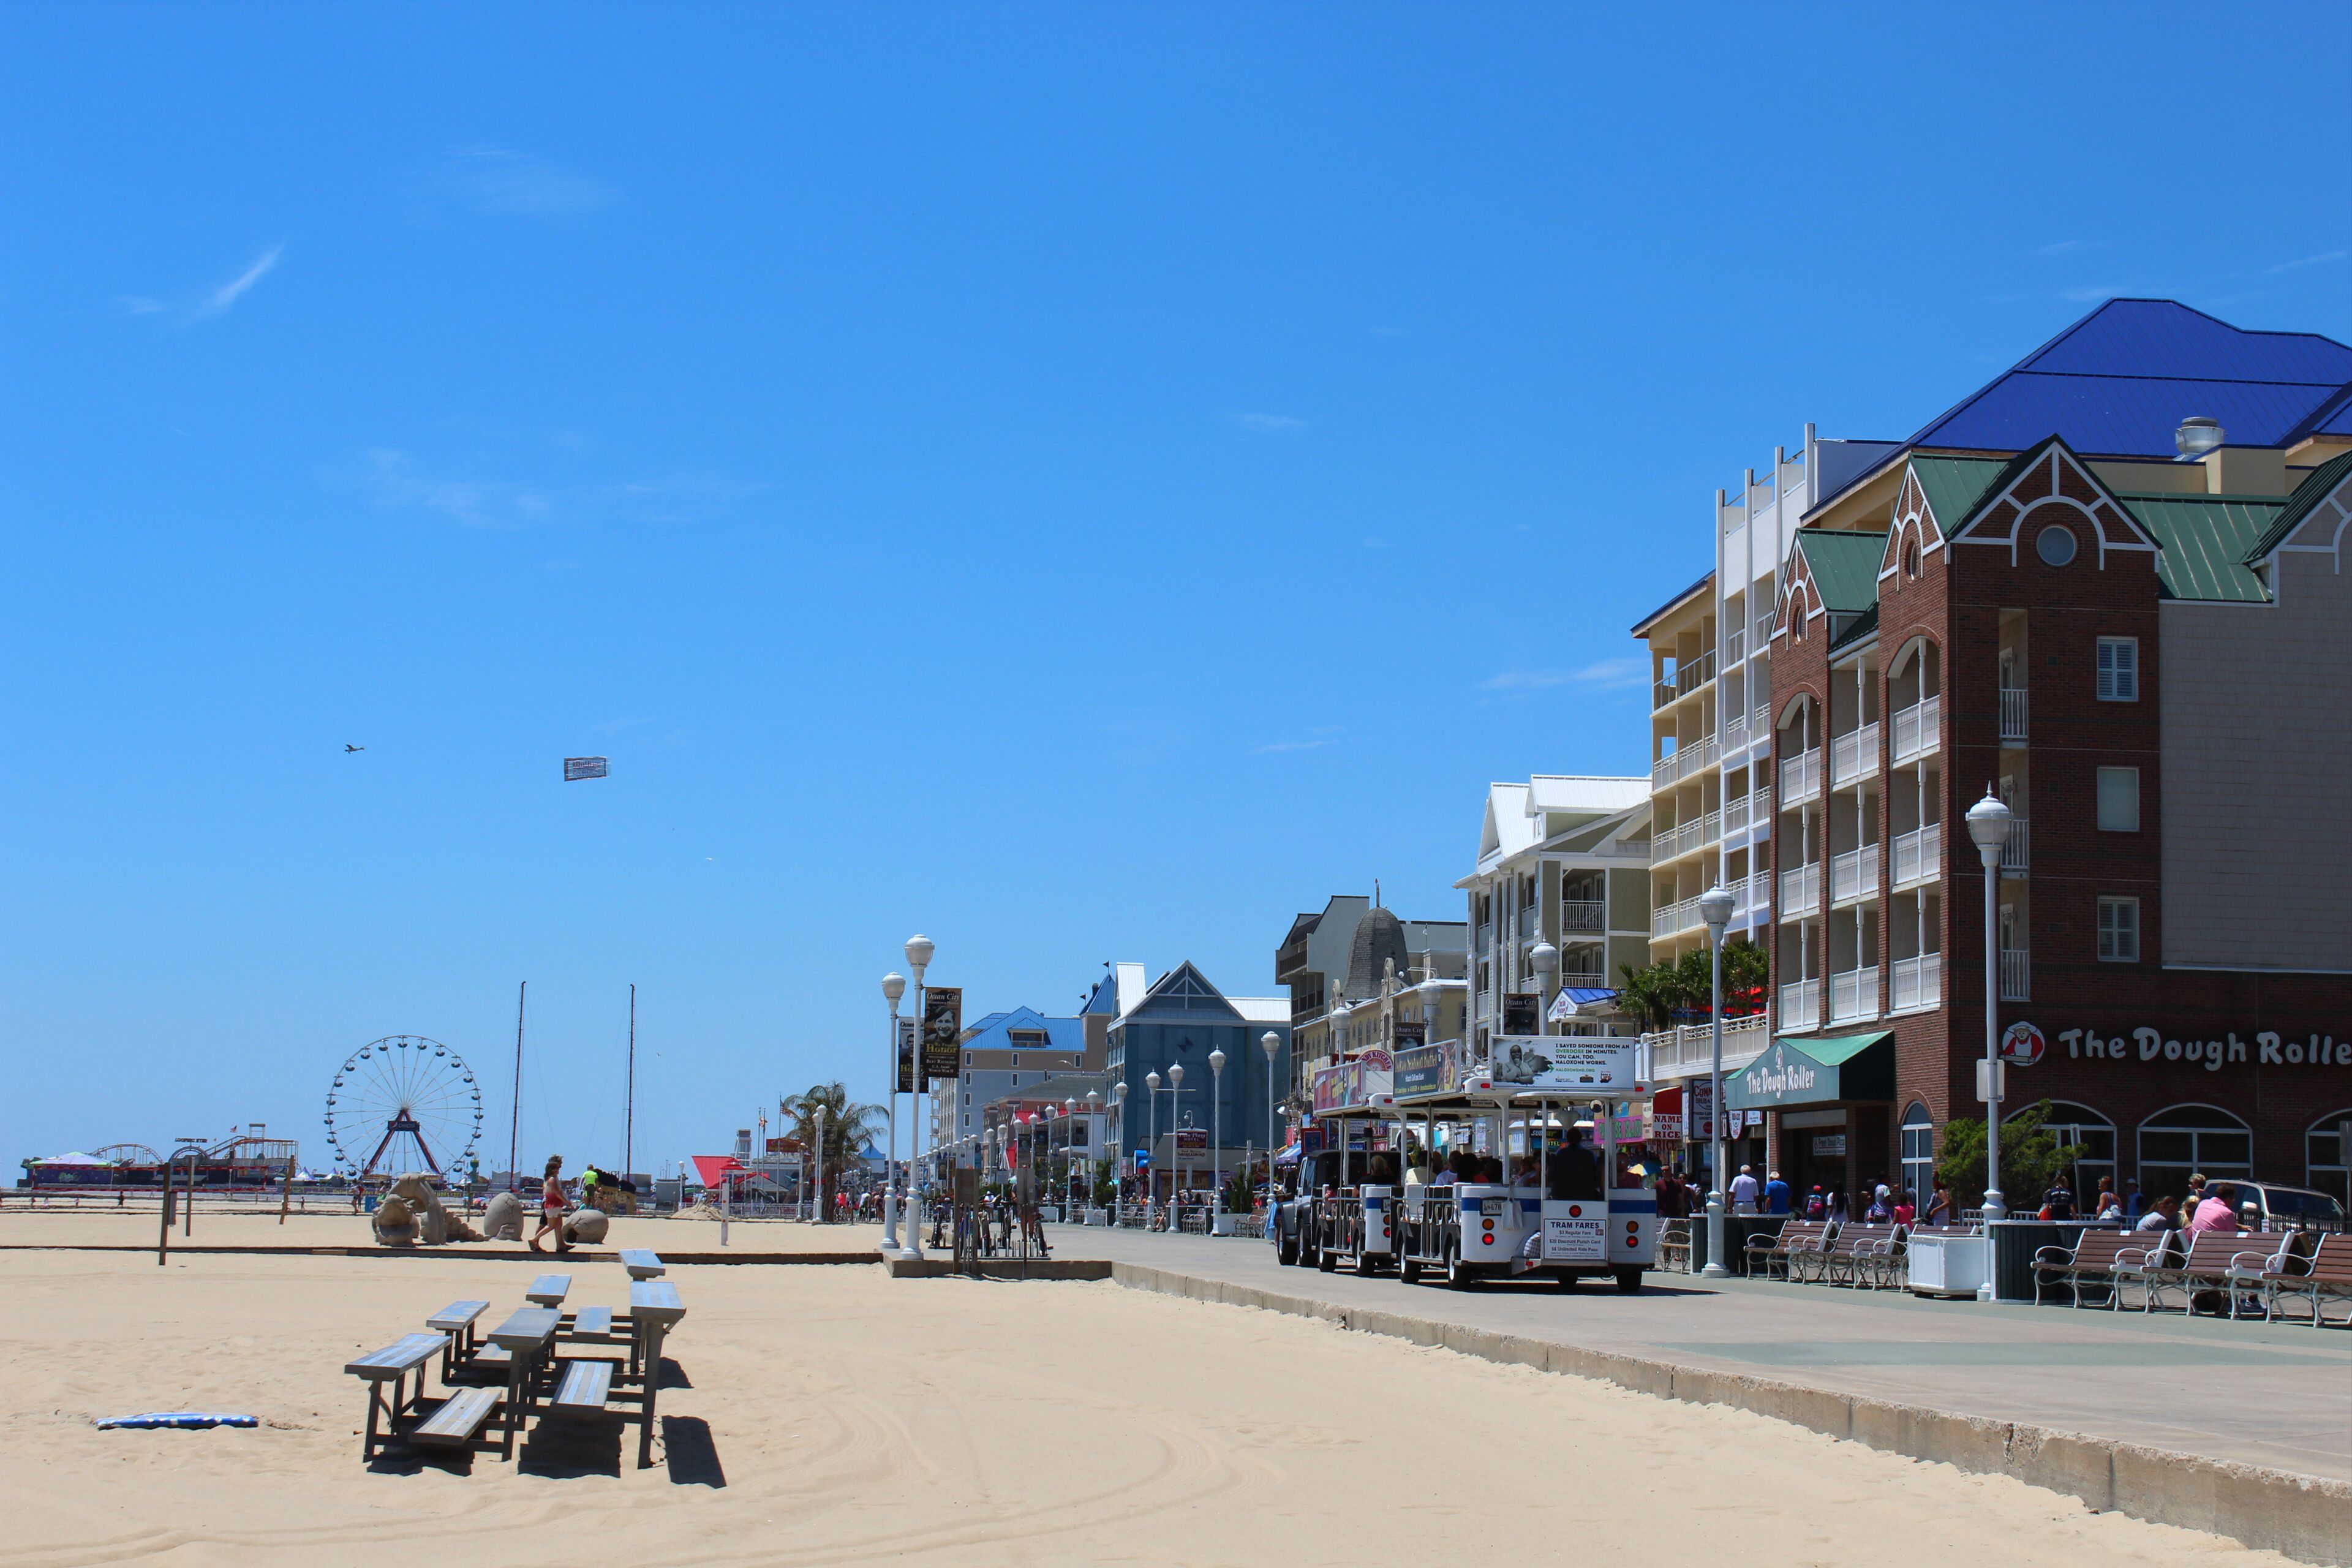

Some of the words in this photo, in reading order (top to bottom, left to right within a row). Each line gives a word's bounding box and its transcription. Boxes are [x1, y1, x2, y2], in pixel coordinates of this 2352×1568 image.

[946, 993, 960, 1002] City
[925, 1043, 958, 1053] Honor
[2058, 1028, 2126, 1058] The
[2133, 1027, 2247, 1071] Dough
[1362, 1053, 1371, 1061] NDY
[1372, 1052, 1392, 1069] KITCHEN
[1746, 1071, 1761, 1095] The
[1762, 1066, 1786, 1099] Dough
[1787, 1064, 1814, 1091] Roller
[1656, 1140, 1676, 1150] RICE
